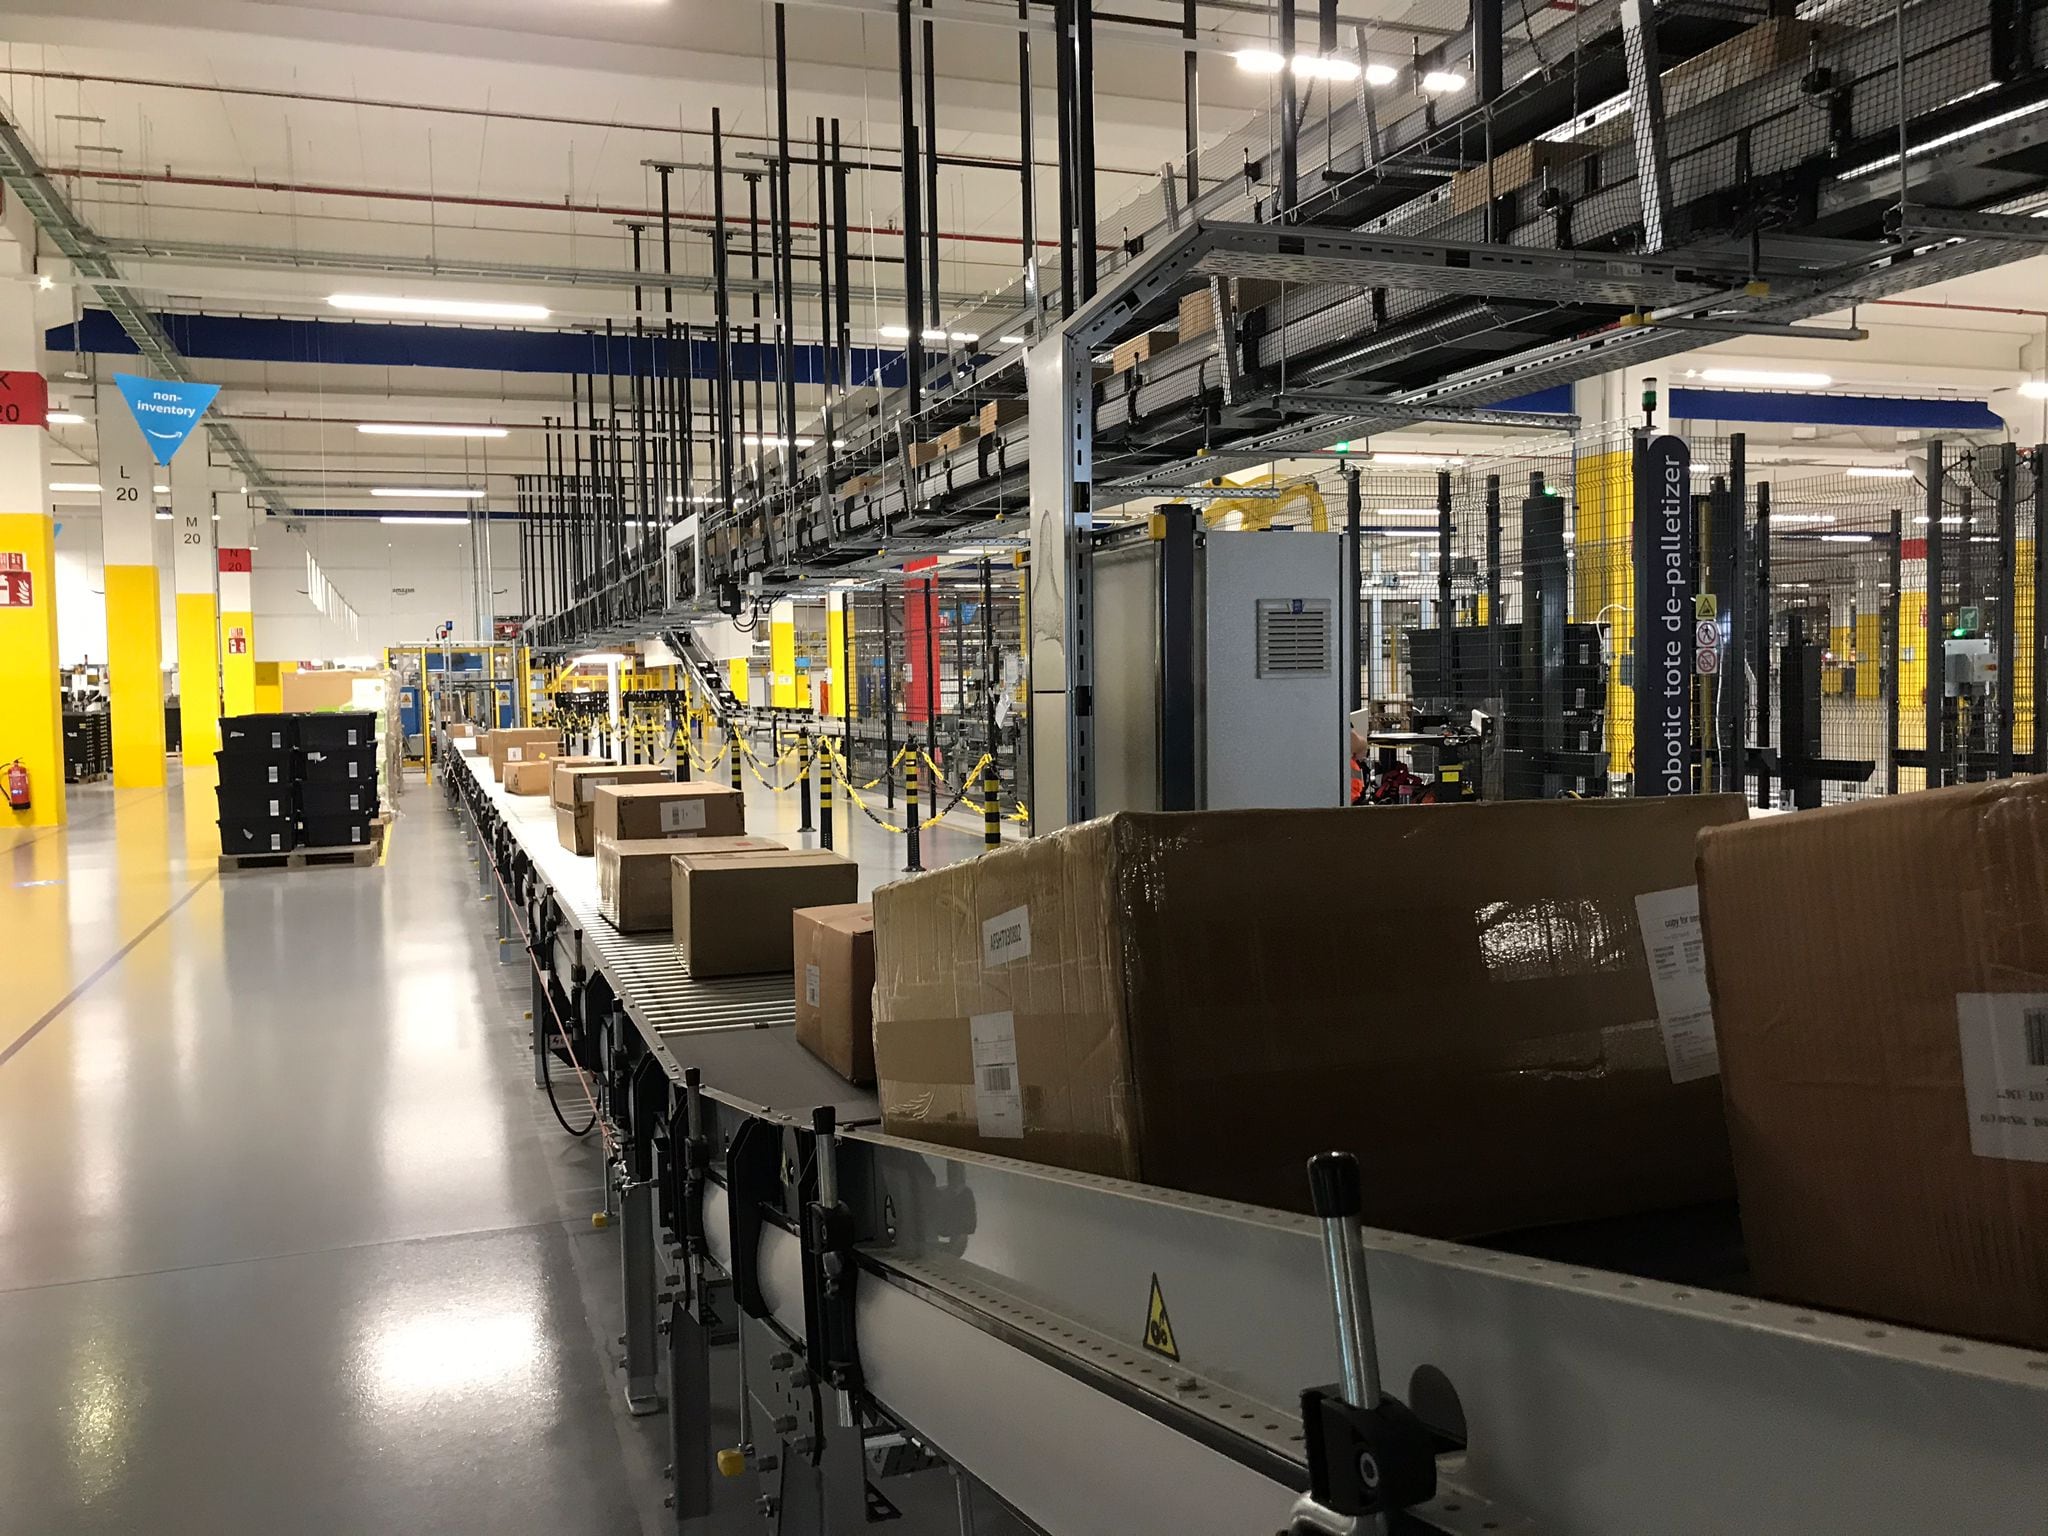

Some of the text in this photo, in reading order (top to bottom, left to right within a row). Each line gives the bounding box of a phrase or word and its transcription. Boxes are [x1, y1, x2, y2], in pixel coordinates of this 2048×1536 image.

[153, 392, 182, 401] non-
[137, 400, 196, 418] inventory
[120, 465, 130, 479] L
[116, 487, 138, 501] 20
[186, 517, 198, 527] M
[184, 533, 201, 544] 20
[1661, 455, 1686, 631] de-palletizer
[228, 562, 243, 572] 20
[1663, 641, 1682, 698] tote
